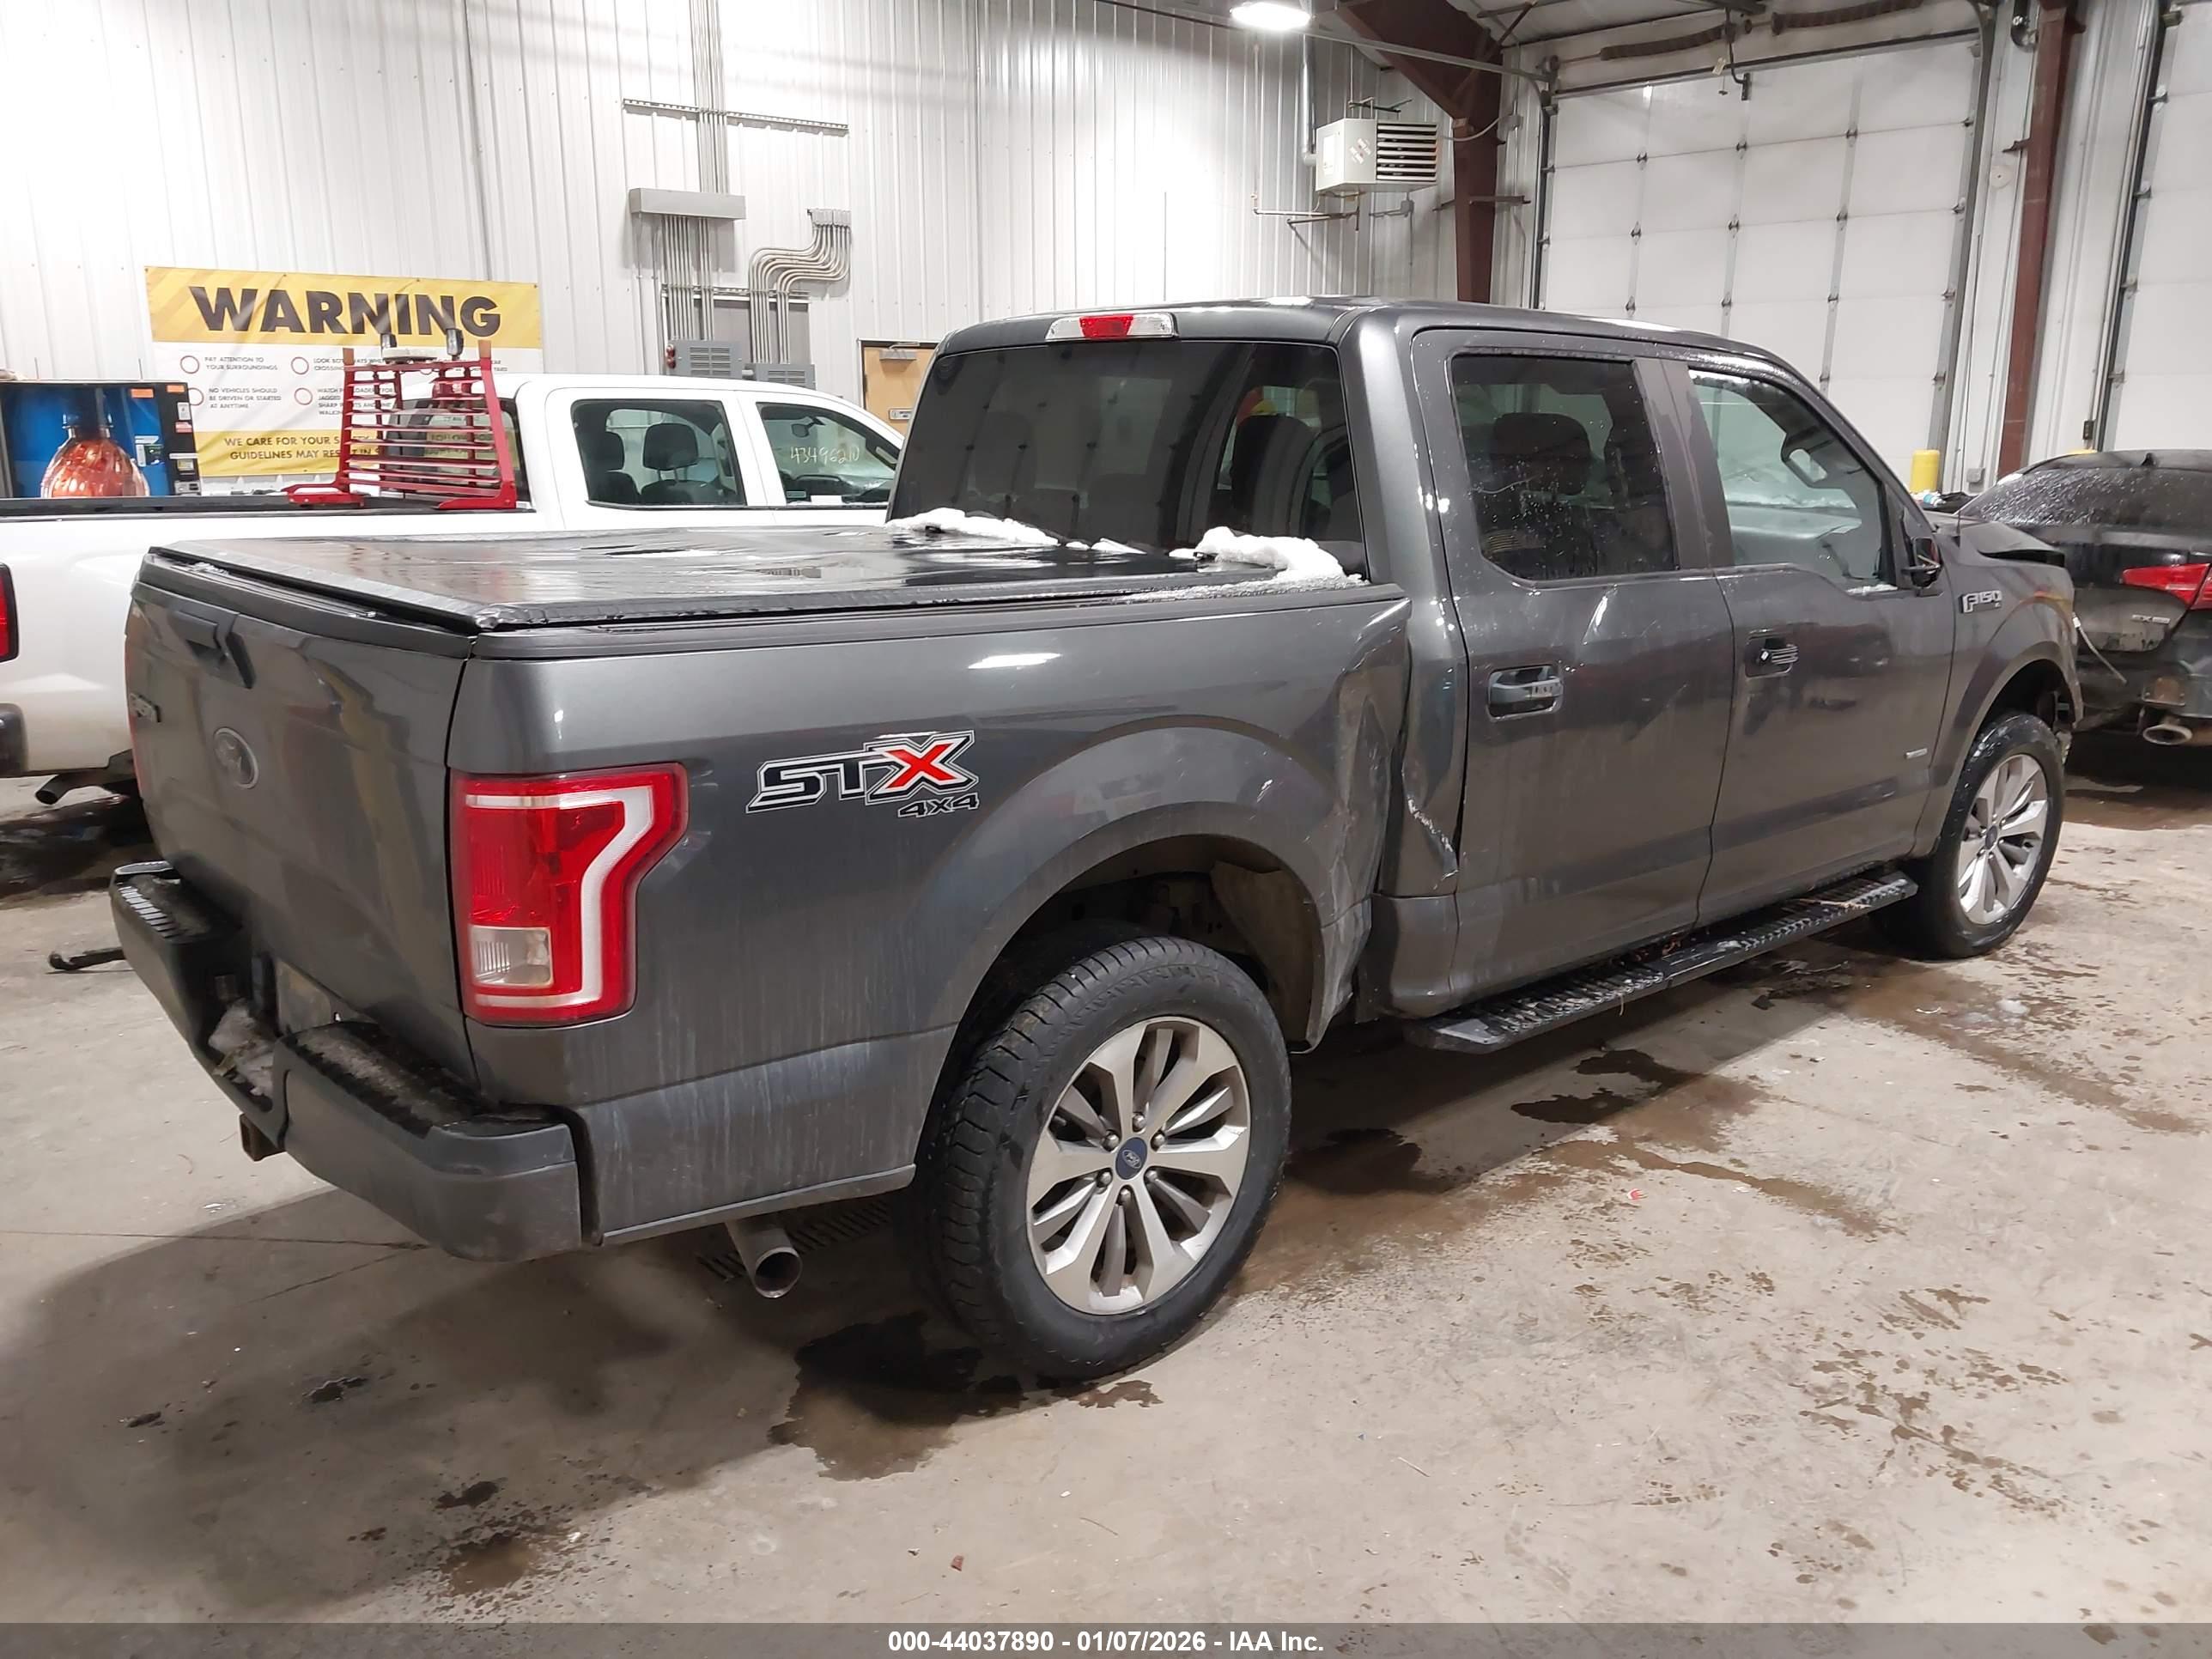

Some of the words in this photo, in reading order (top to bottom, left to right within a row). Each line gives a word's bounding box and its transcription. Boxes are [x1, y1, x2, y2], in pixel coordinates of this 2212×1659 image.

[190, 287, 501, 337] WARNING
[225, 438, 243, 447] WE
[246, 437, 273, 446] CARE
[276, 437, 298, 446] FOR
[301, 436, 331, 445] YOUR
[230, 451, 292, 460] GUIDELINES
[296, 450, 319, 459] MAY
[745, 730, 979, 813] STX
